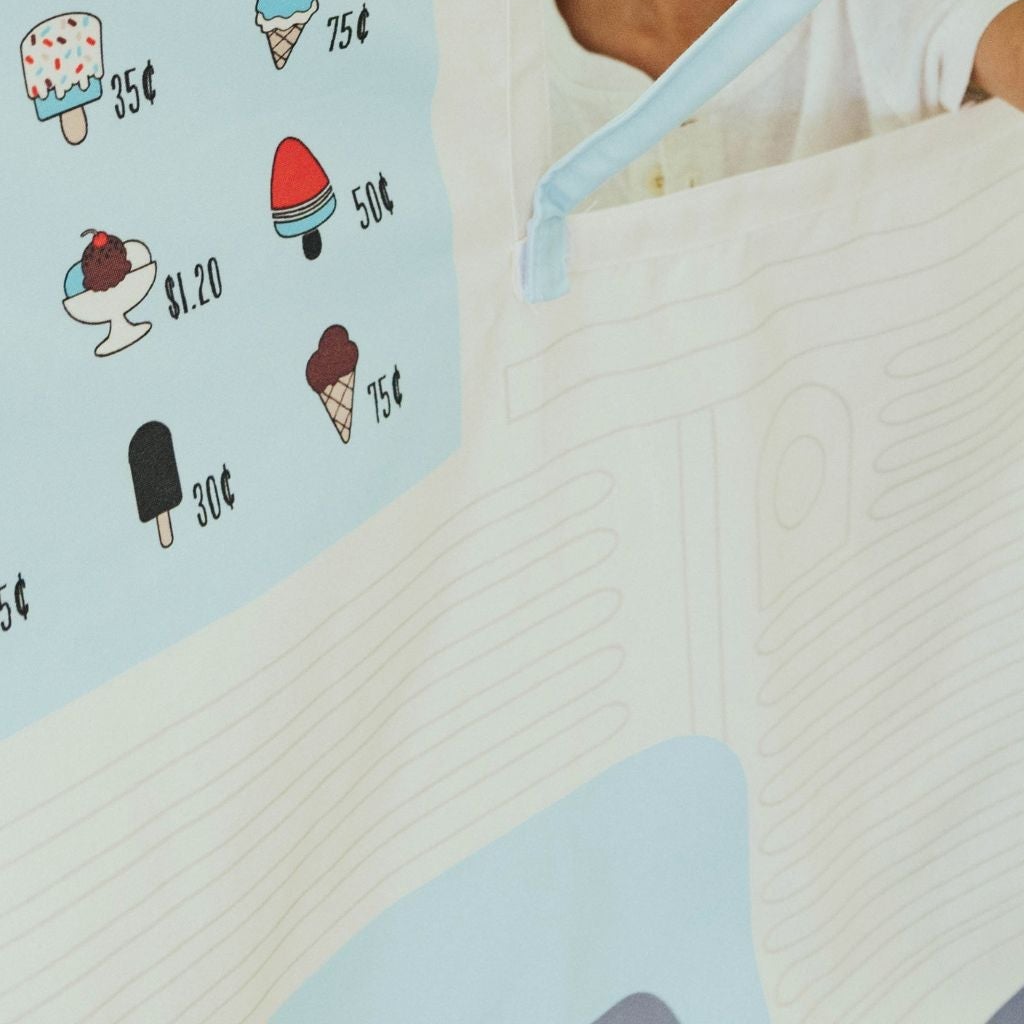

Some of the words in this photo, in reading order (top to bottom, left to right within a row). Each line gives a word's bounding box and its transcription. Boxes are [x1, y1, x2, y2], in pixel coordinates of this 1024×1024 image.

[326, 2, 370, 53] 75¢
[110, 59, 157, 120] 35¢
[351, 171, 395, 230] 50¢
[164, 256, 223, 321] $1.20
[366, 364, 403, 424] 75¢
[192, 463, 236, 528] 30¢
